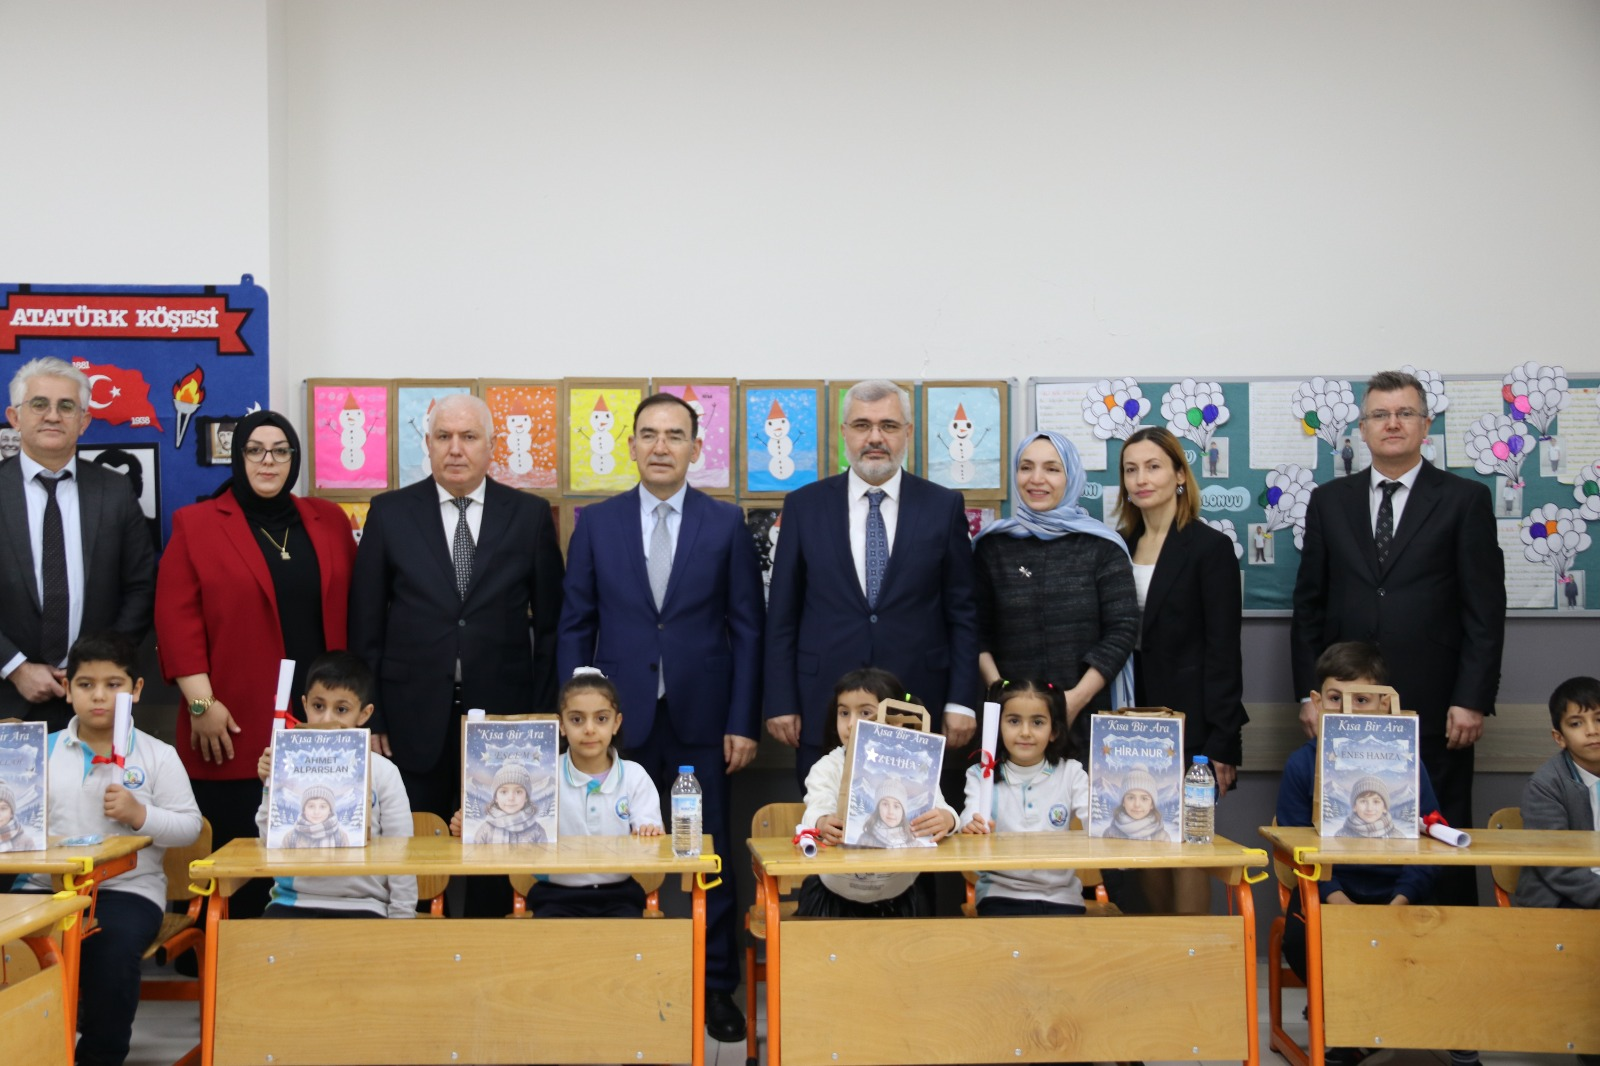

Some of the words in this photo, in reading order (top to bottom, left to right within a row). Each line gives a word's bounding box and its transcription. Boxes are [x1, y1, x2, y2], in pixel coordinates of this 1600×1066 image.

[9, 305, 128, 327] ATATÜRK
[135, 306, 219, 332] KÖŞESİ
[131, 416, 151, 425] 1938
[1131, 721, 1148, 732] Bir
[1149, 722, 1170, 733] Ara
[1364, 720, 1382, 732] Bir
[1382, 721, 1404, 733] Ara
[9, 731, 30, 742] Ara
[314, 734, 331, 744] Bir
[332, 734, 351, 744] Ara
[506, 729, 525, 740] Bir
[524, 729, 545, 741] Ara
[895, 729, 911, 740] Bir
[911, 733, 929, 745] Ara
[1114, 745, 1139, 757] HİRA
[1141, 748, 1163, 758] NUR
[1341, 750, 1364, 760] ENES
[1366, 751, 1401, 761] HAMZA
[304, 756, 338, 764] AHMET
[293, 765, 349, 774] ALPARSLAN
